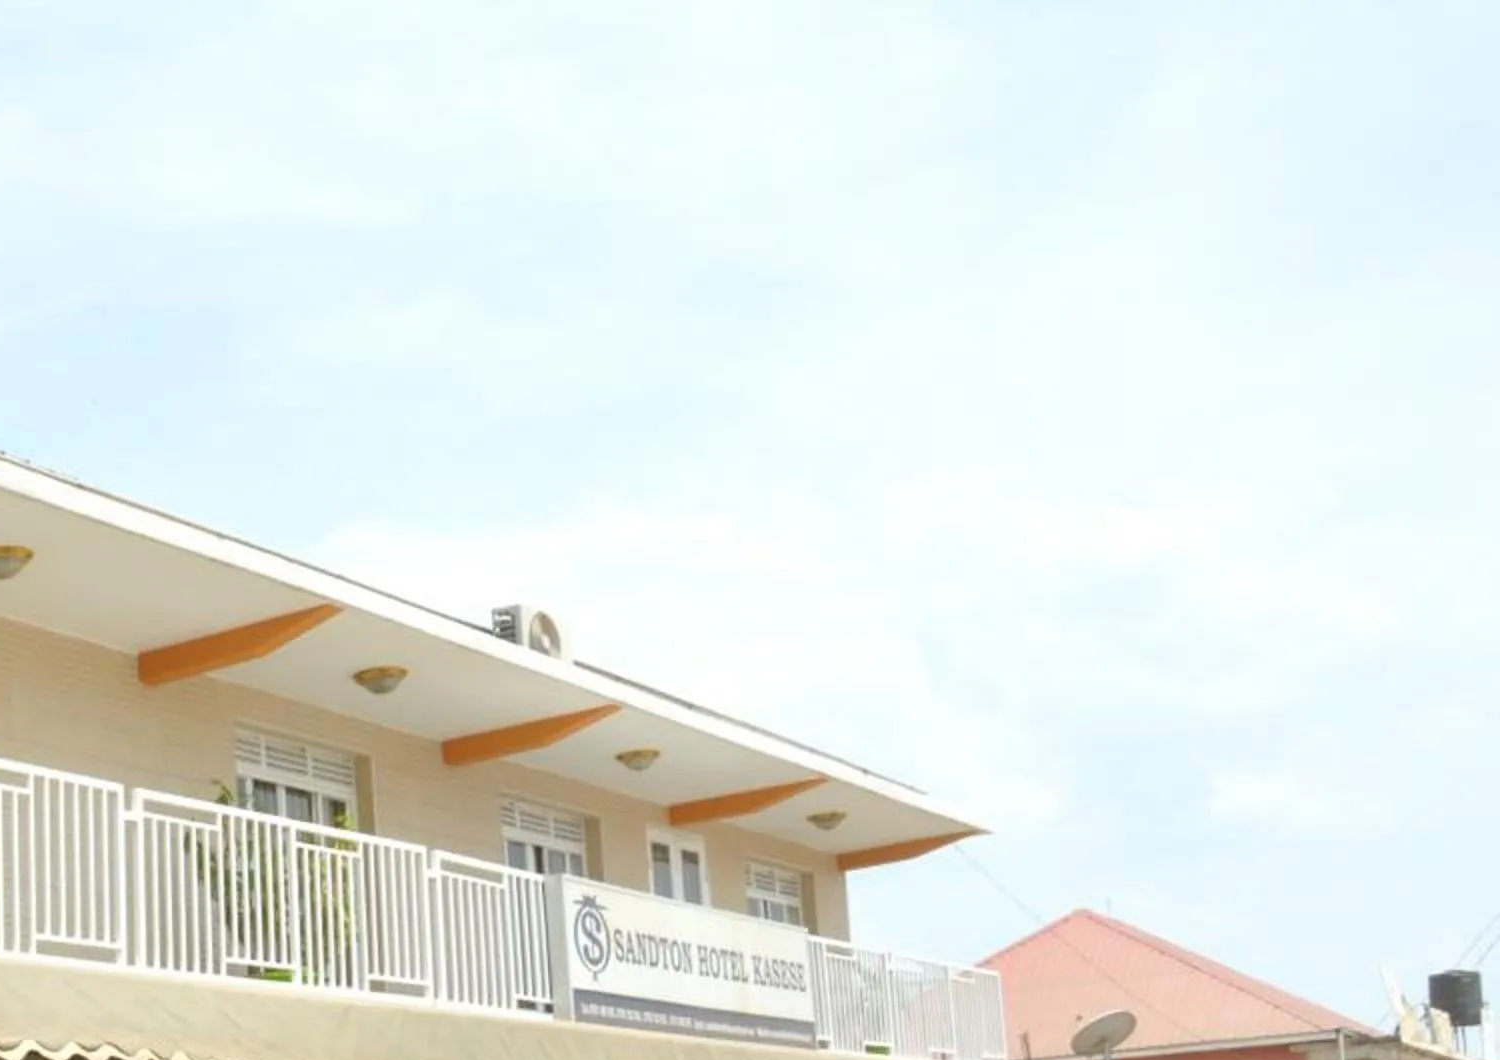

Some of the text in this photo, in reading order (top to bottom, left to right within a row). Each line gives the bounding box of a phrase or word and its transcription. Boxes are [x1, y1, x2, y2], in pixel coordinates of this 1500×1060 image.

[613, 928, 807, 993] SANDTON HOTEL KASESE
